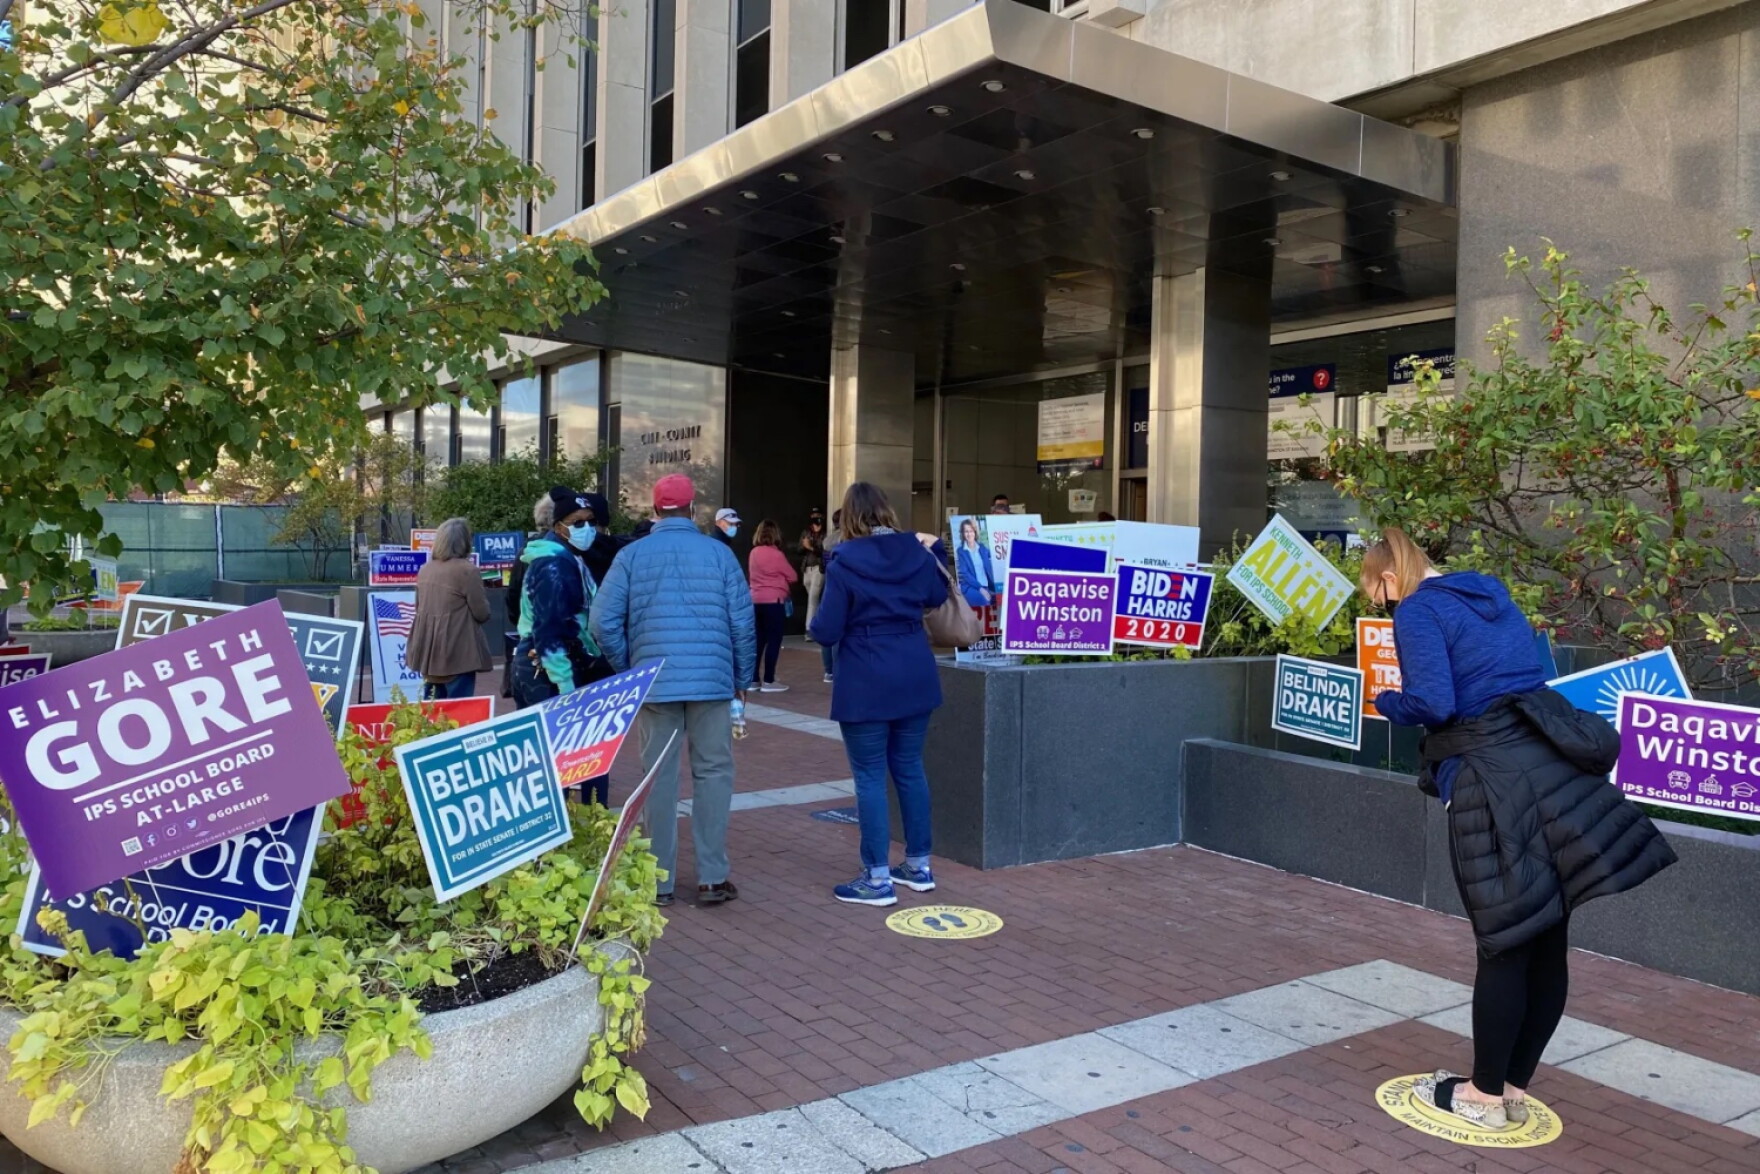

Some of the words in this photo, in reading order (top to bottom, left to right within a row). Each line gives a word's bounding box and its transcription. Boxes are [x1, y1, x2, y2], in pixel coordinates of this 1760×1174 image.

[1282, 373, 1295, 382] the
[484, 536, 515, 551] PAM
[1270, 526, 1304, 560] KENNETH
[385, 555, 415, 563] VANESSA
[1143, 557, 1168, 567] BRYAN
[1014, 576, 1110, 604] Daqavise
[1130, 569, 1199, 600] BIDEN
[1236, 564, 1254, 581] FOR
[1250, 576, 1267, 595] IPS
[1244, 539, 1340, 628] ALLEN
[1017, 600, 1103, 622] Winston
[1127, 595, 1193, 621] HARRIS
[1009, 640, 1024, 649] IPS
[1025, 640, 1050, 649] School
[1050, 641, 1072, 649] Board
[1125, 619, 1186, 641] 2020
[7, 628, 264, 731] ELIZABETH
[1283, 671, 1352, 701] BELINDA
[25, 652, 292, 790] GORE
[556, 686, 640, 727] GLORIA
[1281, 689, 1352, 724] DRAKE
[83, 797, 118, 822] IPS
[121, 771, 204, 809] SCHOOL
[206, 742, 275, 777] BOARD
[425, 739, 540, 801] BELINDA
[135, 776, 245, 827] AT-LARGE
[206, 793, 270, 822] @GORE4IPS
[436, 769, 549, 847] DRAKE
[1622, 782, 1643, 793] IPS
[1646, 786, 1692, 802] School
[1695, 794, 1735, 810] Board
[452, 851, 467, 863] FOR
[467, 848, 475, 857] IN
[475, 839, 493, 852] STATE
[493, 828, 516, 844] SENATE
[520, 815, 543, 832] DISTRICT
[150, 831, 296, 892] ore
[1400, 1113, 1469, 1141] MAINTAIN
[1473, 1134, 1531, 1145] SOCIAL
